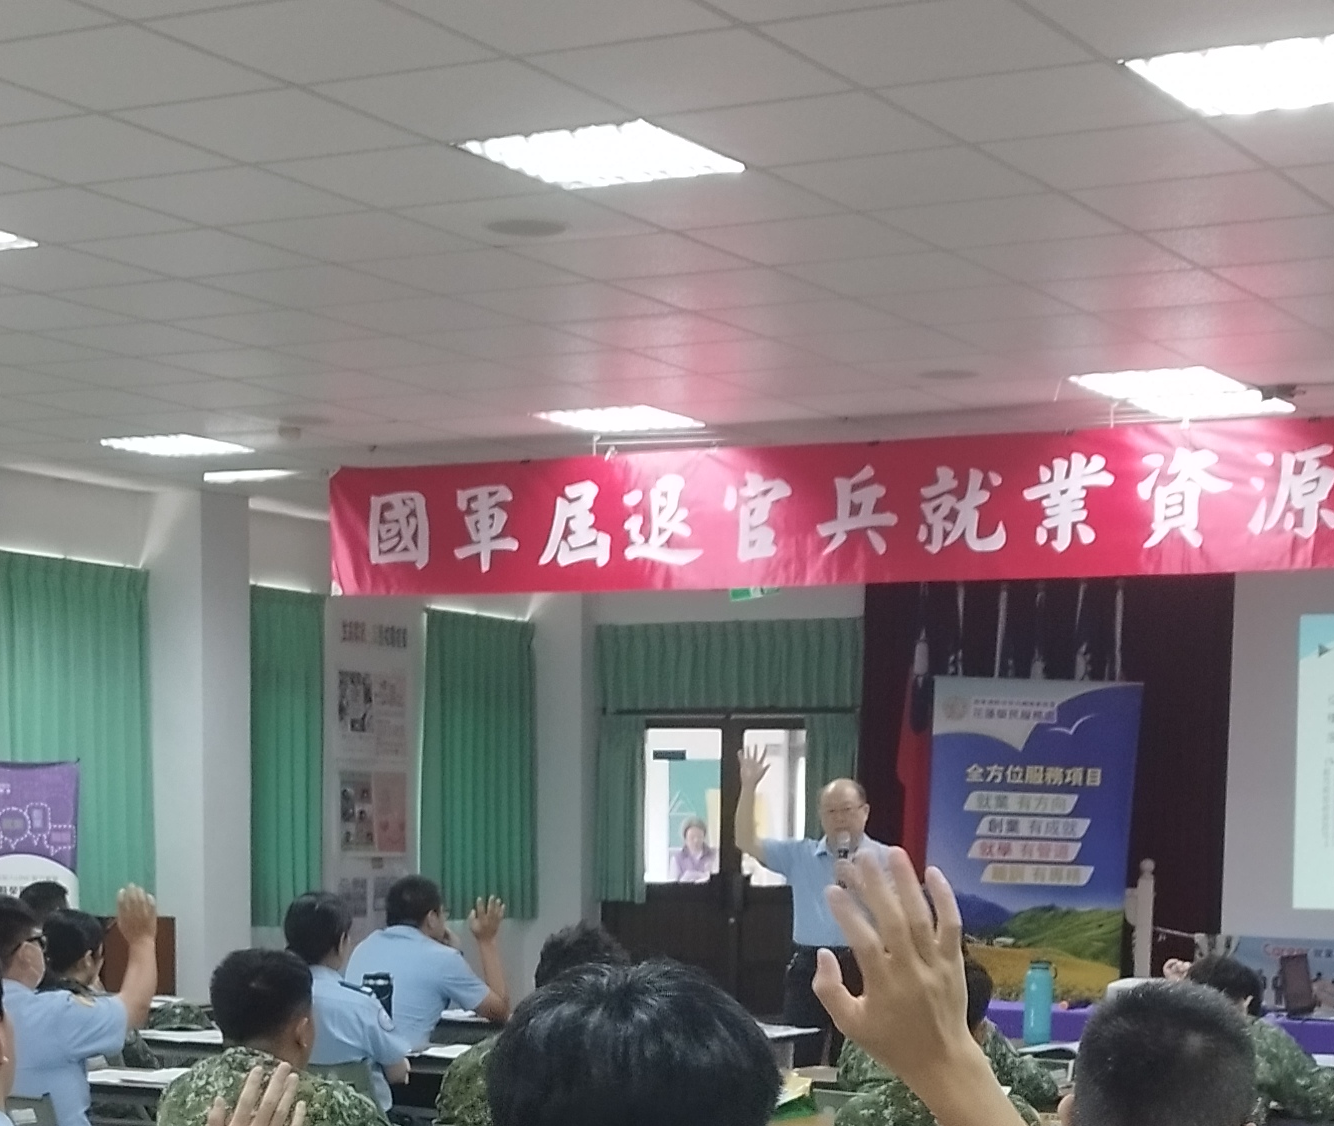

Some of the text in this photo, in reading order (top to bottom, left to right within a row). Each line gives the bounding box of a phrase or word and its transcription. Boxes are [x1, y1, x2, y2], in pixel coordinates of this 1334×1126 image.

[965, 763, 1102, 787] 全方位服務項目
[988, 818, 1019, 834] 創業
